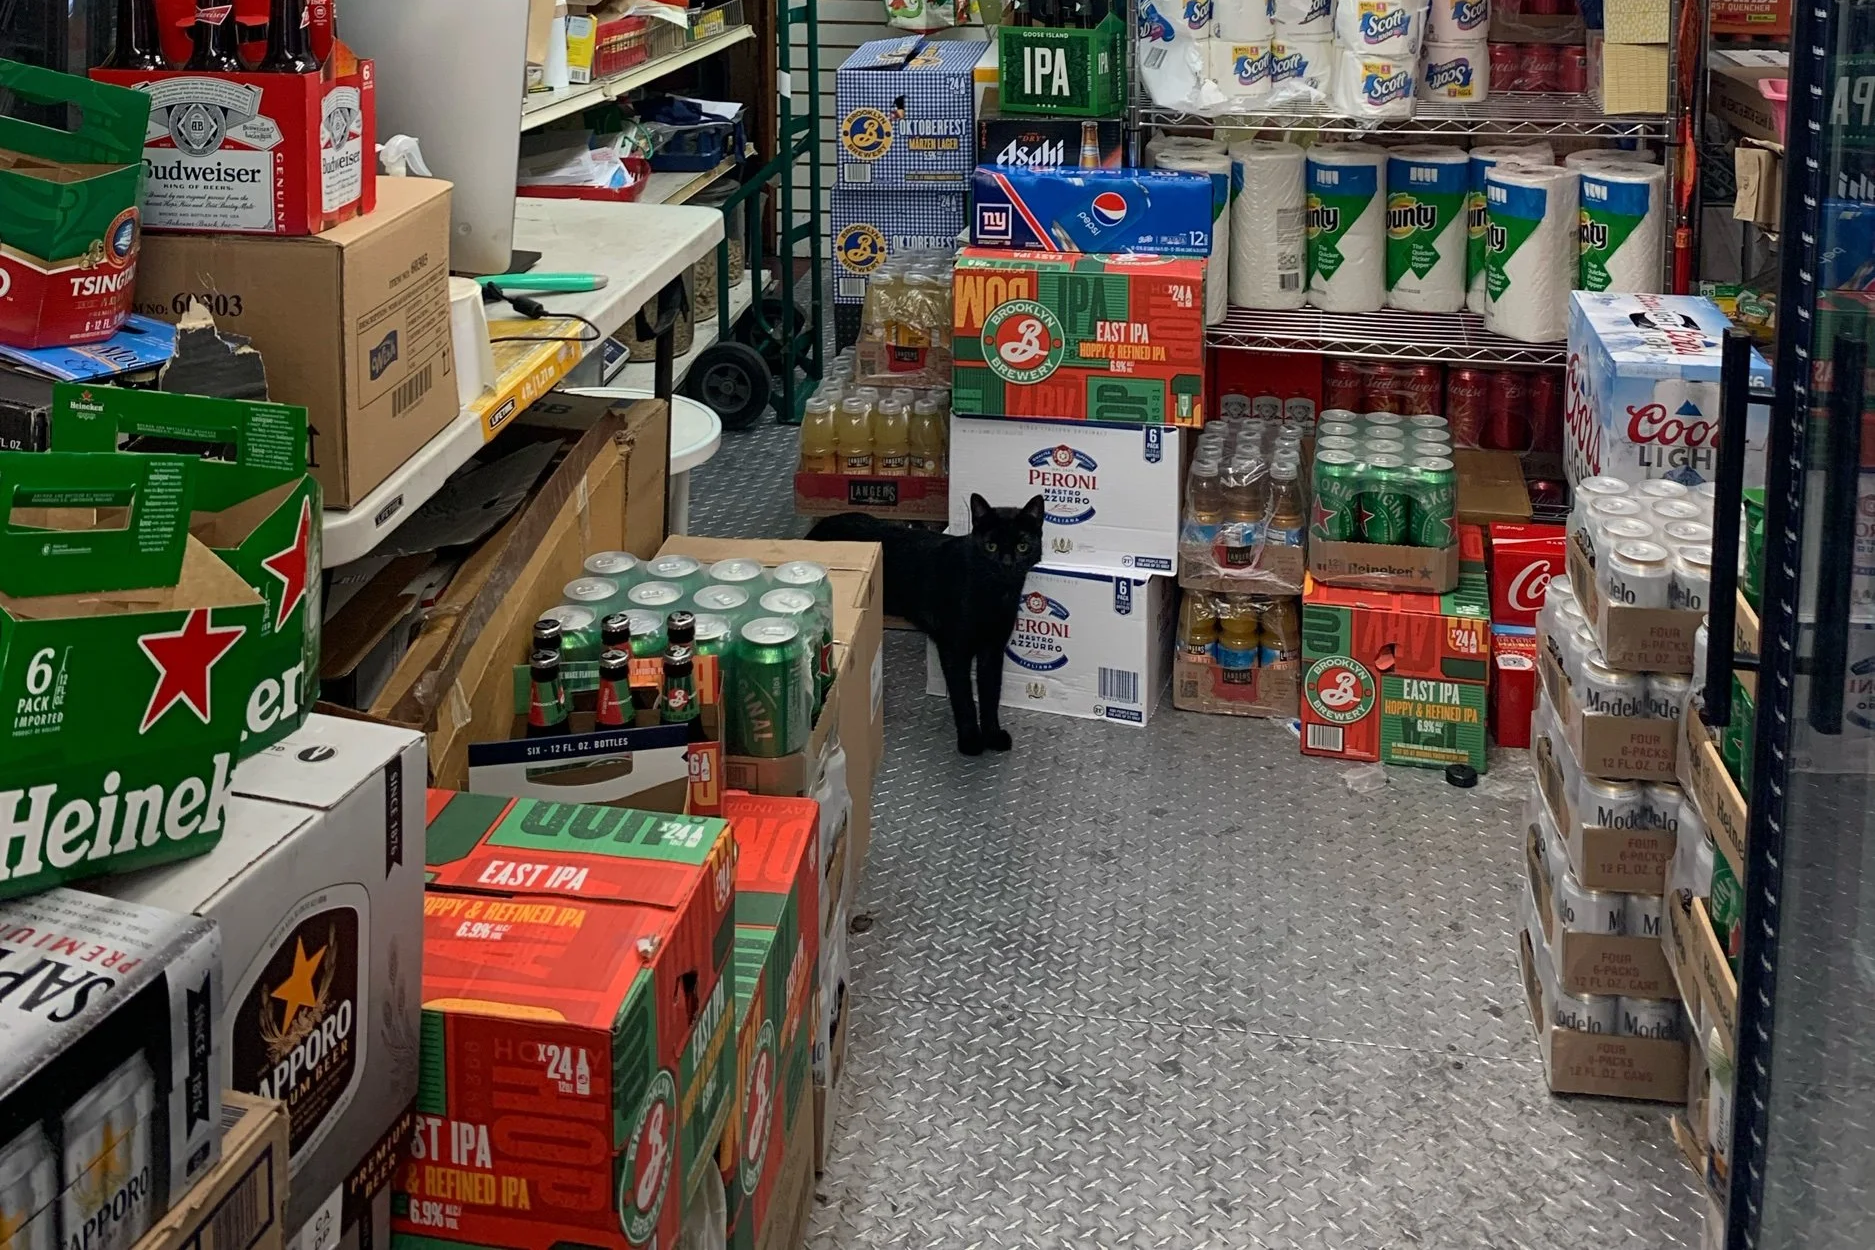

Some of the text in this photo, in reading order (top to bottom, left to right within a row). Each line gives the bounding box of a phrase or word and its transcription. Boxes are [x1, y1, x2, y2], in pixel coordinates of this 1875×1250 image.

[1728, 3, 1771, 12] QUENCHER
[1367, 9, 1404, 36] Scott
[362, 65, 371, 80] 6
[1023, 46, 1070, 97] IPA
[1098, 51, 1109, 75] IPA
[1271, 53, 1301, 80] Scott
[1370, 70, 1408, 98] Scott
[1431, 65, 1466, 90] Scott
[847, 108, 887, 125] BROOKLYN
[899, 118, 967, 136] OKTOBERFEST
[847, 143, 888, 159] BREWERY
[937, 138, 959, 150] LAGER
[996, 139, 1064, 166] Asahi
[322, 150, 361, 175] Budweiser
[276, 152, 286, 233] GENUINE
[982, 211, 1007, 230] ny
[1077, 210, 1102, 236] pepsi
[1189, 230, 1204, 246] 12
[1412, 249, 1435, 257] Quicker
[146, 304, 169, 316] NO:
[991, 302, 1056, 328] BROOKLYN
[1096, 321, 1149, 345] EAST IPA
[1079, 342, 1166, 361] HOPPY & REFINED IPA
[990, 355, 1056, 382] BREWERY
[1110, 361, 1127, 373] 6.9%
[70, 401, 104, 412] Heineken
[490, 398, 516, 427] LIFETIME
[1148, 428, 1157, 443] 6
[1147, 442, 1159, 450] PACK
[1639, 446, 1712, 470] LIGH
[1028, 468, 1097, 490] PERONI
[1044, 487, 1081, 497] NASTRO
[1044, 494, 1090, 505] ZZURRO
[1045, 514, 1080, 524] ITALIANA
[1119, 580, 1127, 595] 6
[1015, 618, 1070, 638] ERONI
[1650, 627, 1681, 638] FOUR
[1010, 639, 1062, 653] AZZURRO
[1018, 634, 1054, 644] NASTRO
[1641, 640, 1689, 651] 6-PACKS
[26, 647, 56, 695] 6
[1020, 659, 1053, 670] ITALIANA
[1313, 659, 1368, 681] BROOKLYN
[564, 669, 576, 680] MAKE
[1403, 678, 1460, 705] EAST IPA
[17, 695, 50, 714] PACK
[1313, 699, 1367, 721] BREWERY
[1384, 699, 1478, 724] HOPPY & REFINED IPA
[14, 711, 64, 729] IMPORTED
[1416, 719, 1435, 733] 6.9%
[527, 736, 629, 756] SIX 12 FL. OZ. BOTTLES
[1630, 733, 1661, 745] FOUR
[1621, 745, 1669, 759] 6-PACKS
[690, 753, 700, 774] 6
[1602, 758, 1615, 768] 12
[389, 771, 400, 856] SINCE 1876
[1628, 838, 1659, 850] FOUR
[1620, 851, 1666, 863] 6-PACKS
[477, 859, 589, 891] EAST IPA
[1600, 863, 1613, 873] 12
[424, 897, 587, 929] OPPY & REFINED IPA
[456, 921, 493, 939] 6.9%
[1601, 952, 1632, 964] FOUR
[1593, 965, 1640, 978] 6-PACKS
[1574, 976, 1660, 991] 12 CANS
[257, 999, 352, 1100] APPORO
[1597, 1043, 1627, 1055] FOUR
[315, 1040, 349, 1082] BEER
[351, 1113, 411, 1195] PREMIUM
[451, 1120, 493, 1169] IPA
[365, 1152, 398, 1199] BEER
[405, 1164, 531, 1210] & REFINED IPA
[315, 1209, 332, 1233] CA
[410, 1199, 445, 1227] 6.9%
